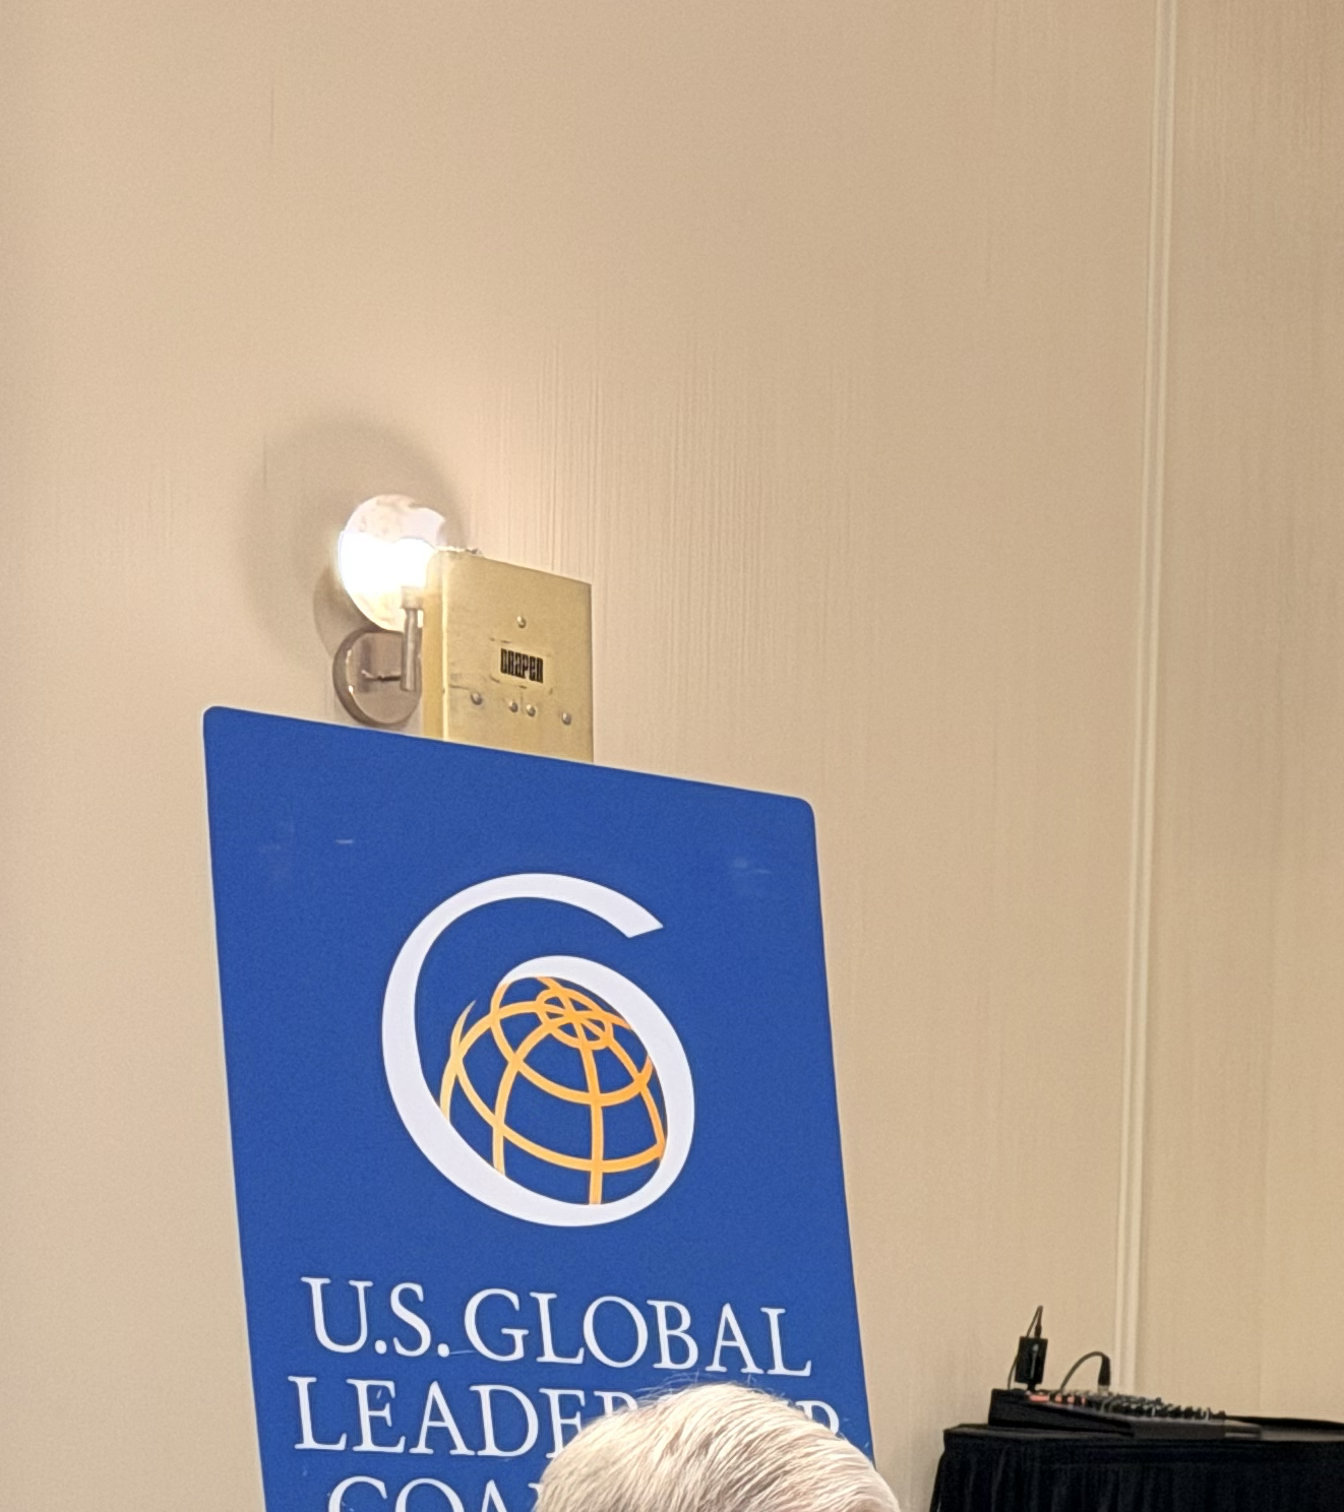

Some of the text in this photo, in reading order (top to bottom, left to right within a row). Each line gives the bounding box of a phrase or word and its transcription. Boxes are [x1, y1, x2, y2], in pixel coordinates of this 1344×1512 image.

[300, 1276, 813, 1377] U.S. GLOBAL
[287, 1375, 841, 1460] LEADE
